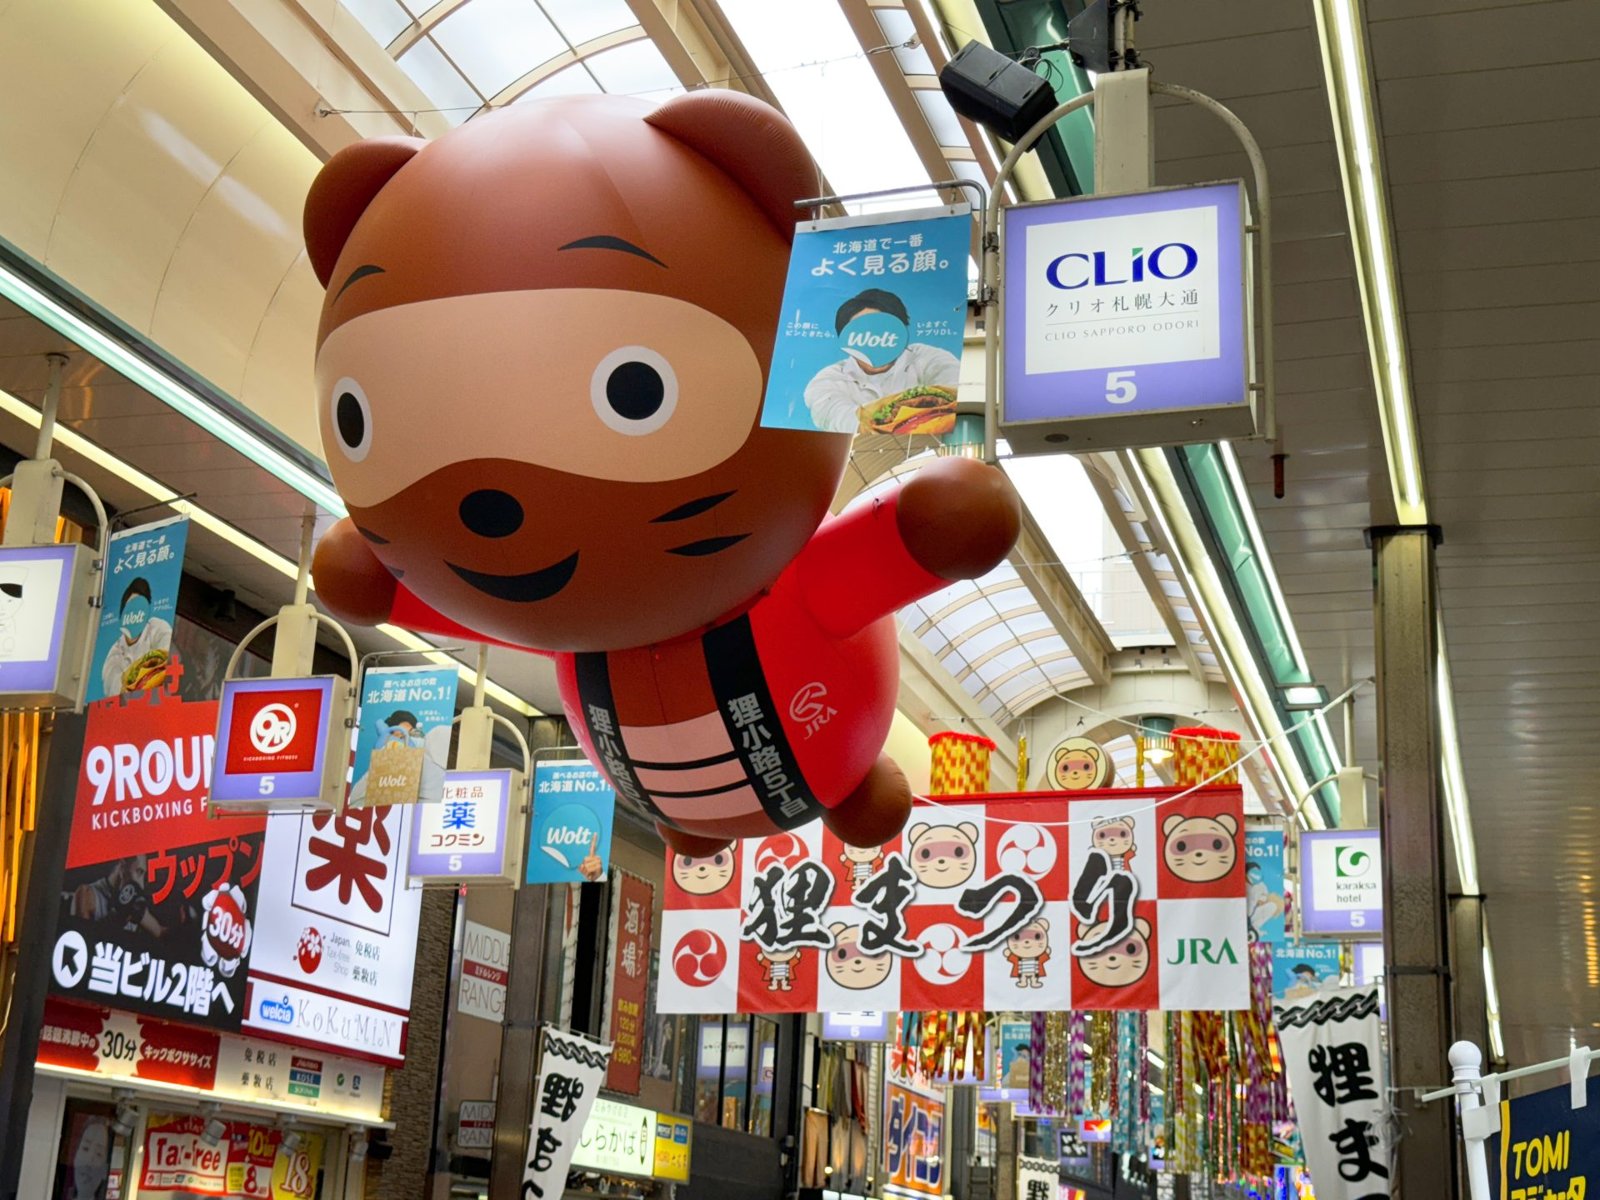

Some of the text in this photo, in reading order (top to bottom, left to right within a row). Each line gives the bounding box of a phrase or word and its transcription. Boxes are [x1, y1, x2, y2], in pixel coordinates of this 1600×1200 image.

[832, 233, 924, 255] 北海道で一番
[811, 249, 949, 277] よく見る顔。
[1046, 288, 1199, 318] クリオ札幌大通
[848, 331, 899, 348] Wolt
[1044, 318, 1200, 342] CLIO SAPPORO ODORI
[1105, 370, 1137, 404] 5
[113, 545, 175, 574] よく見る顔。
[122, 610, 145, 626] Wolt
[803, 706, 838, 741] JRA
[258, 775, 275, 795] 5
[378, 773, 407, 788] Wolt
[442, 785, 484, 800] 化粧品
[91, 798, 193, 831] KICKBOXING
[442, 801, 477, 830] 薬
[430, 833, 485, 848] コクミン
[546, 826, 592, 846] Wolt
[448, 854, 463, 872] 5
[743, 850, 1138, 956] 狸まつり
[1336, 893, 1362, 904] hotel
[208, 904, 245, 950] 30分
[1350, 911, 1366, 928] 5
[1166, 937, 1239, 966] JRA
[88, 940, 235, 1016] 当ビル2階へ
[262, 1000, 293, 1023] welcia
[101, 1029, 138, 1061] 30分
[1512, 1129, 1570, 1180] TOMI
